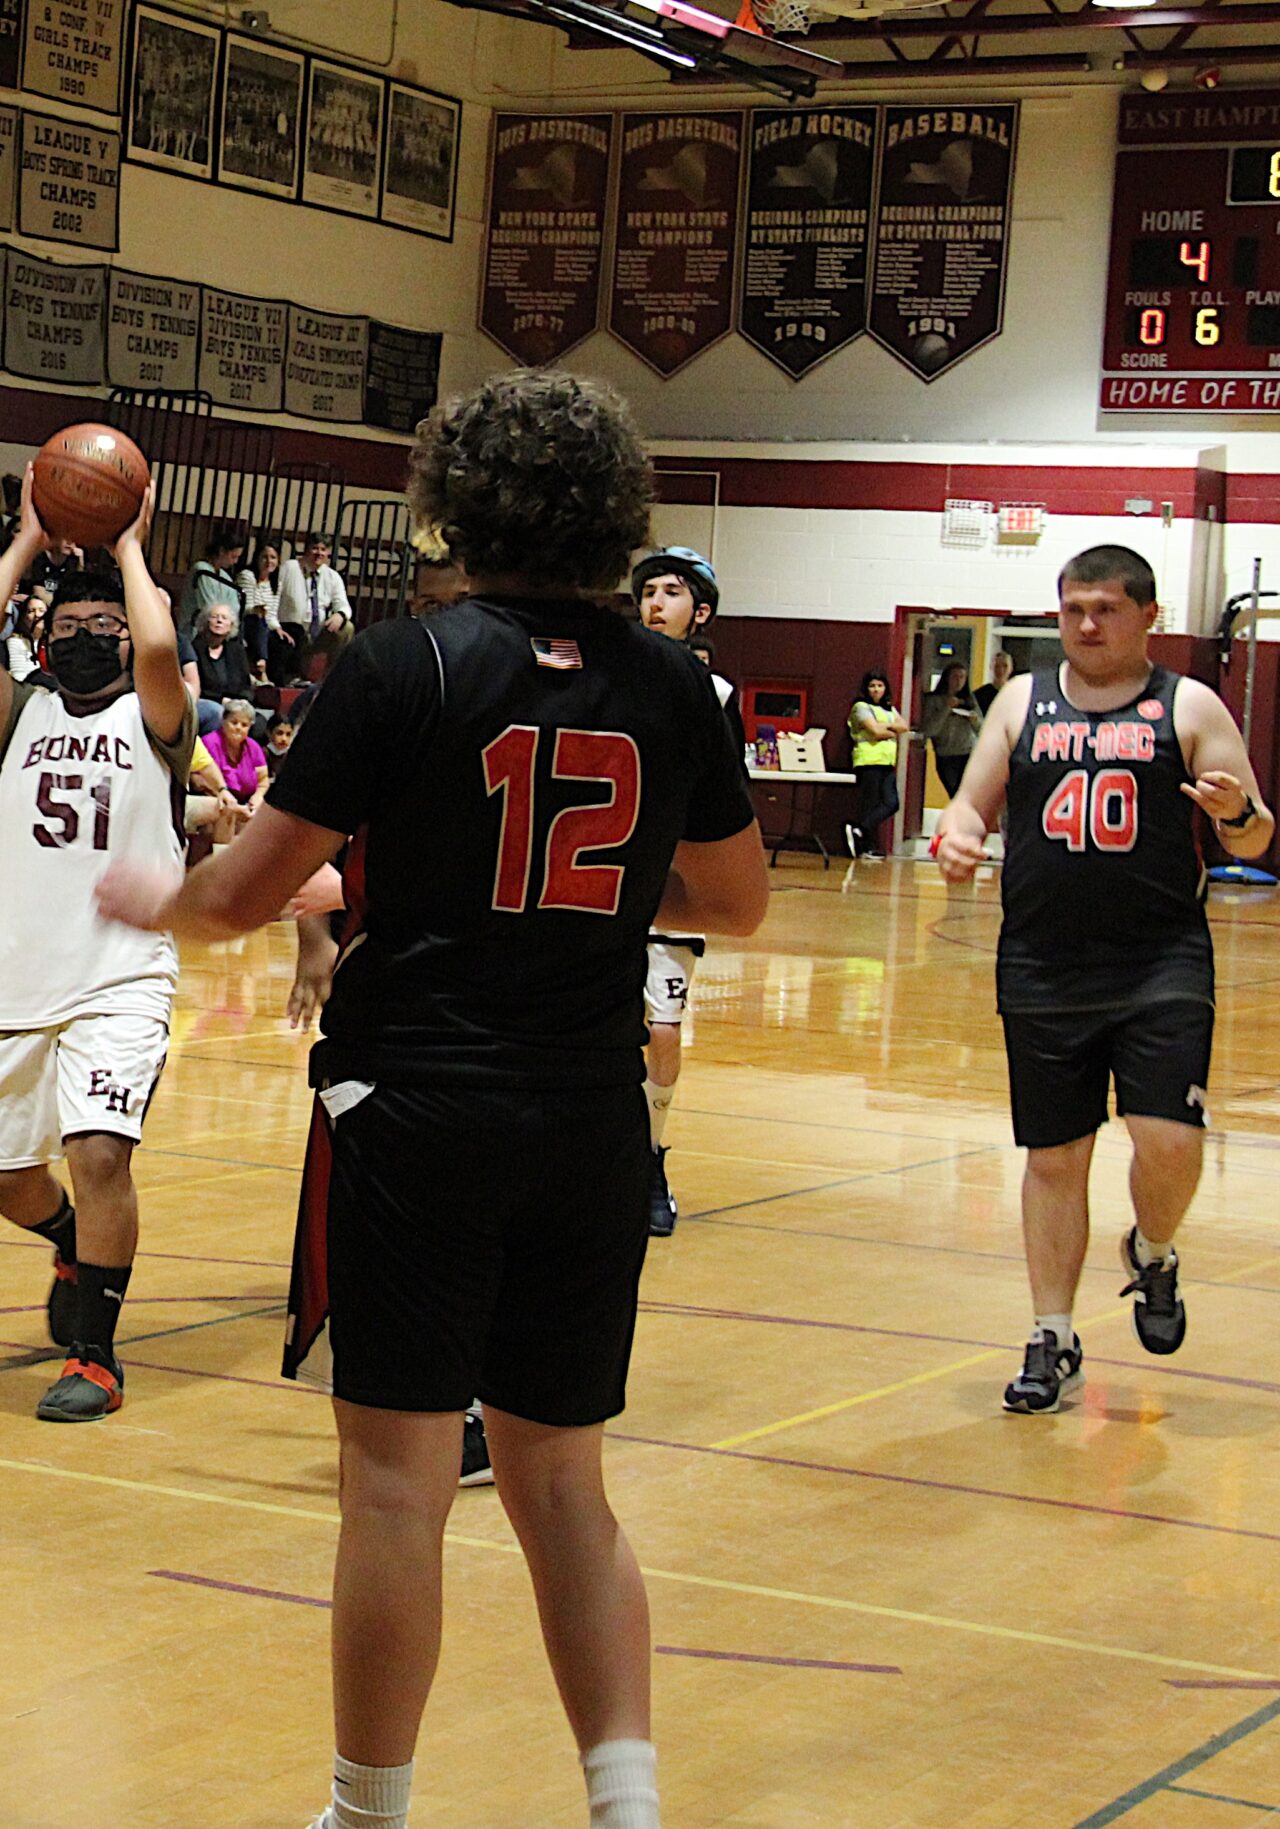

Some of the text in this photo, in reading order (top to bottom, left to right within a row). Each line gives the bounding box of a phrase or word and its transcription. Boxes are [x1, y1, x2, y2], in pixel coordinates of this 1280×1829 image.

[34, 25, 112, 61] GIRLS TRACK
[48, 51, 99, 77] CHAMPS
[34, 126, 92, 155] LEAGUE
[754, 114, 872, 151] FIELD HOCKEY
[887, 111, 1009, 148] BASEBALL
[40, 182, 97, 210] CHAMPS
[52, 210, 82, 232] 2002
[1141, 210, 1205, 232] HOME
[1180, 242, 1211, 283] 4
[14, 264, 76, 295] DIVISION
[8, 288, 101, 321] BOYS TENNIS
[117, 280, 173, 308] DIVISION
[1125, 291, 1171, 307] FOULS
[111, 304, 196, 337] BOYS TENNIS
[206, 295, 260, 323] LEAGUE
[26, 320, 83, 346] CHAMPS
[208, 316, 262, 343] DIVISION
[907, 317, 957, 340] 1991
[1139, 308, 1220, 346] 0 6
[127, 333, 179, 360] CHAMPS
[205, 336, 281, 364] BOYS TENNIS
[1121, 353, 1168, 368] SCORE
[139, 362, 164, 383] 2017
[219, 359, 267, 384] CHAMPS
[1109, 380, 1189, 406] HOME
[1200, 381, 1237, 407] OF
[22, 734, 133, 770] BONAC
[33, 771, 112, 850] 51
[481, 724, 641, 916] 12
[1041, 768, 1138, 852] 40
